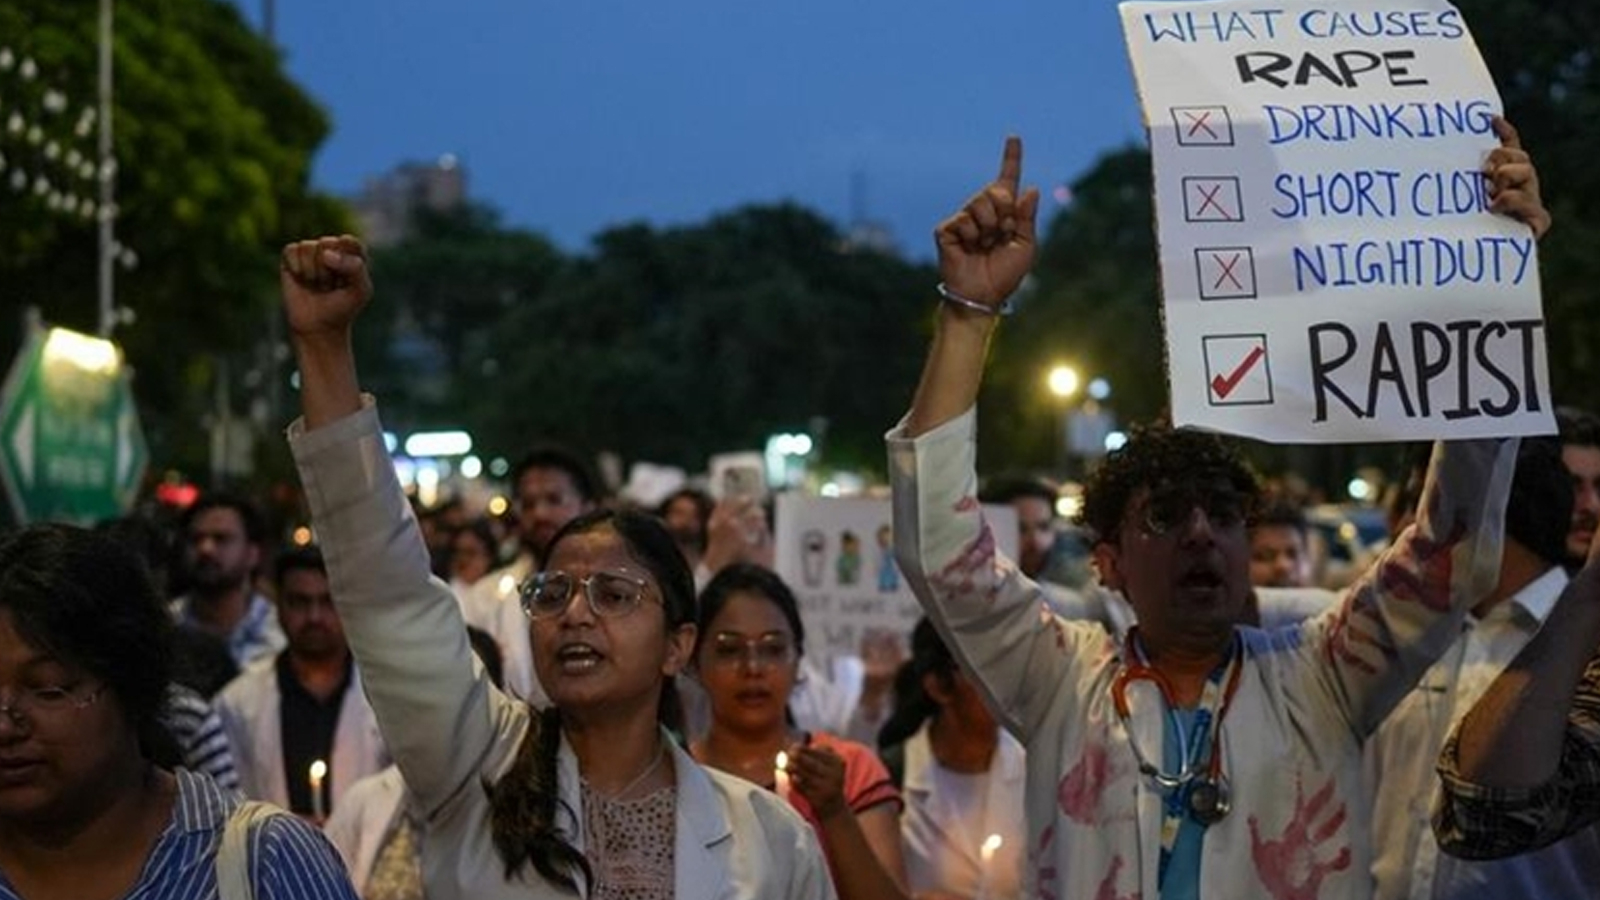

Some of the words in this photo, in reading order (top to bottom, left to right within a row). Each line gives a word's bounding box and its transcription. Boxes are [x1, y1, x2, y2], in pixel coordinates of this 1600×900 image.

[1145, 10, 1283, 42] WHAT
[1301, 9, 1464, 39] CAUSES
[1235, 51, 1428, 88] RAPE
[1264, 101, 1496, 144] DRINKING
[1272, 171, 1399, 218] SHORT
[1308, 319, 1543, 423] RAPIST
